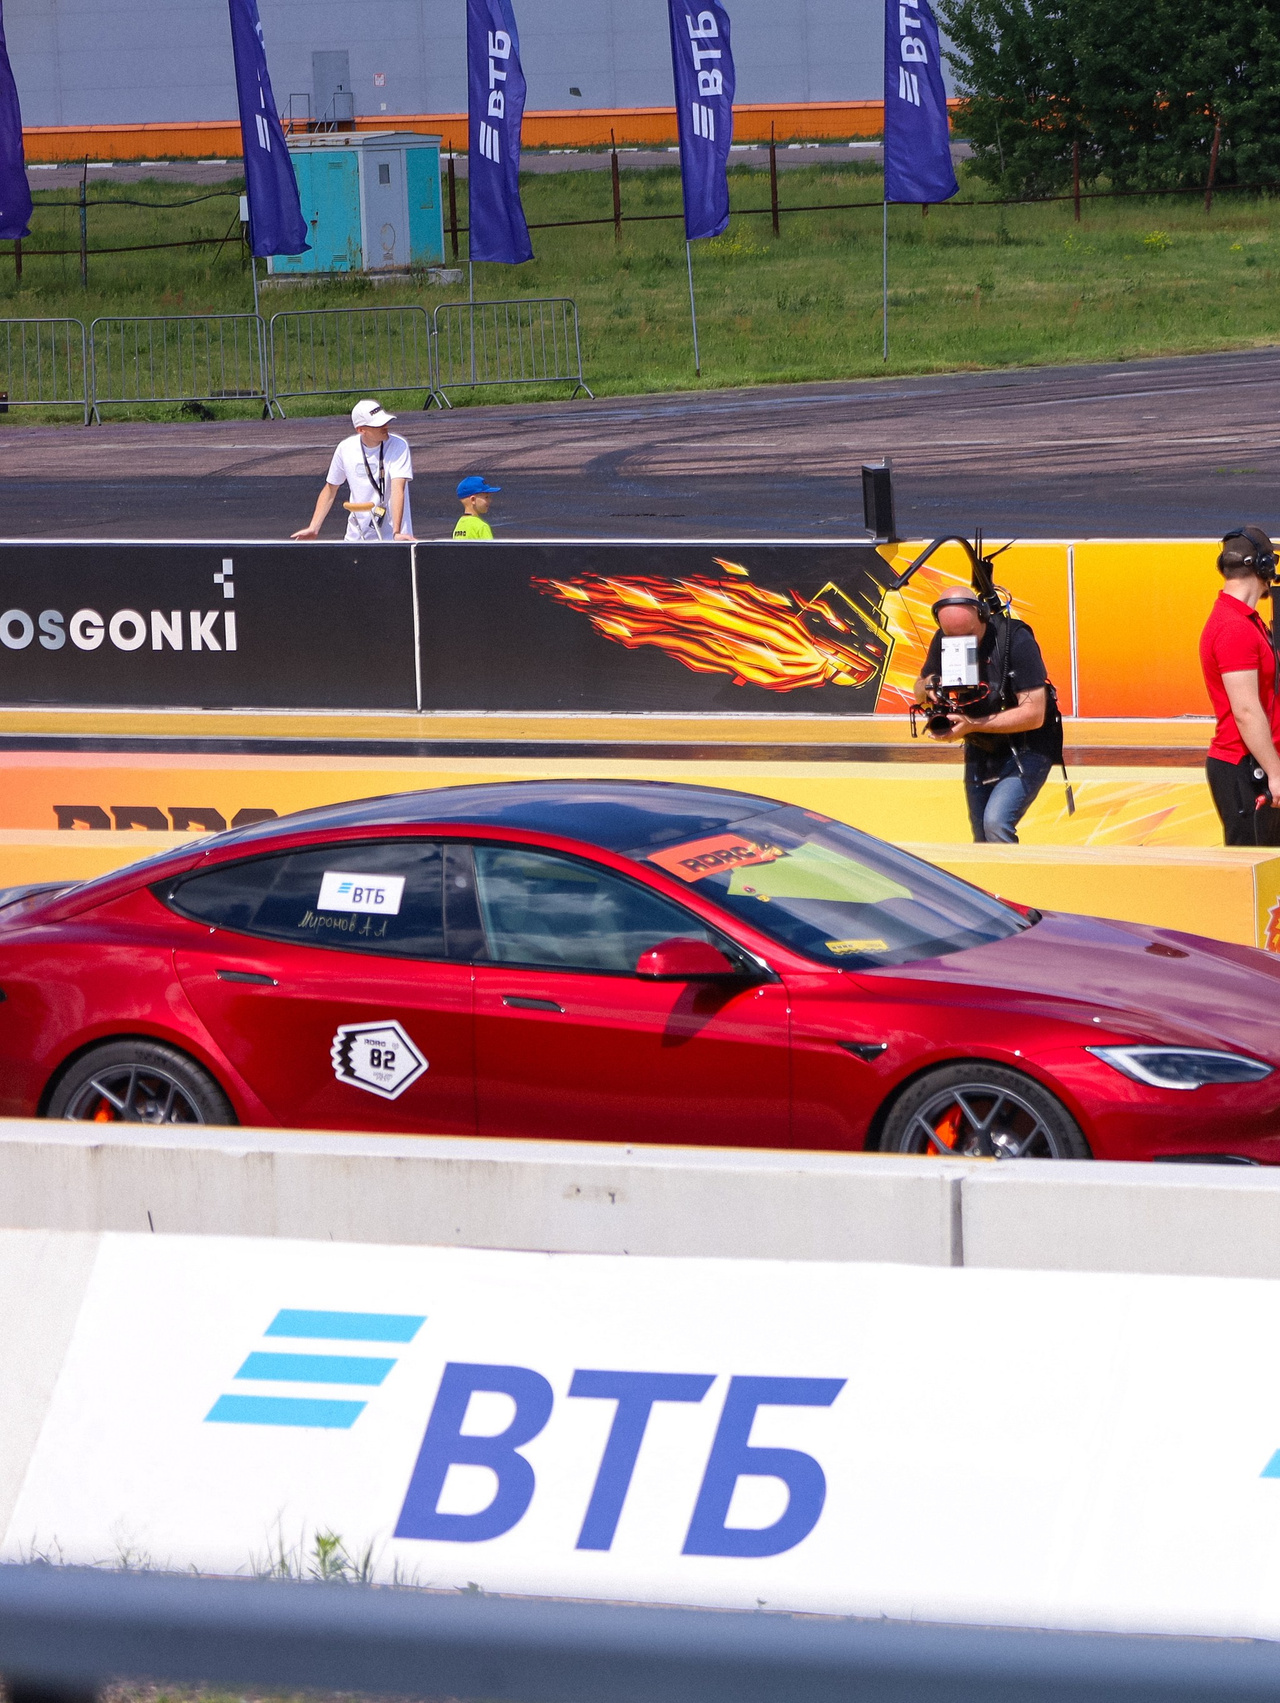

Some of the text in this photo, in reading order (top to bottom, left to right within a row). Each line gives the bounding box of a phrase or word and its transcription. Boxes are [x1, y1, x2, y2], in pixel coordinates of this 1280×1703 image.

[488, 30, 512, 119] ВТБ
[685, 10, 722, 97] ВТБ
[0, 608, 237, 651] OSGONKI
[676, 846, 757, 873] RDRC
[352, 887, 386, 905] ВТБ
[370, 1048, 396, 1071] 82
[392, 1361, 849, 1558] ВТБ
